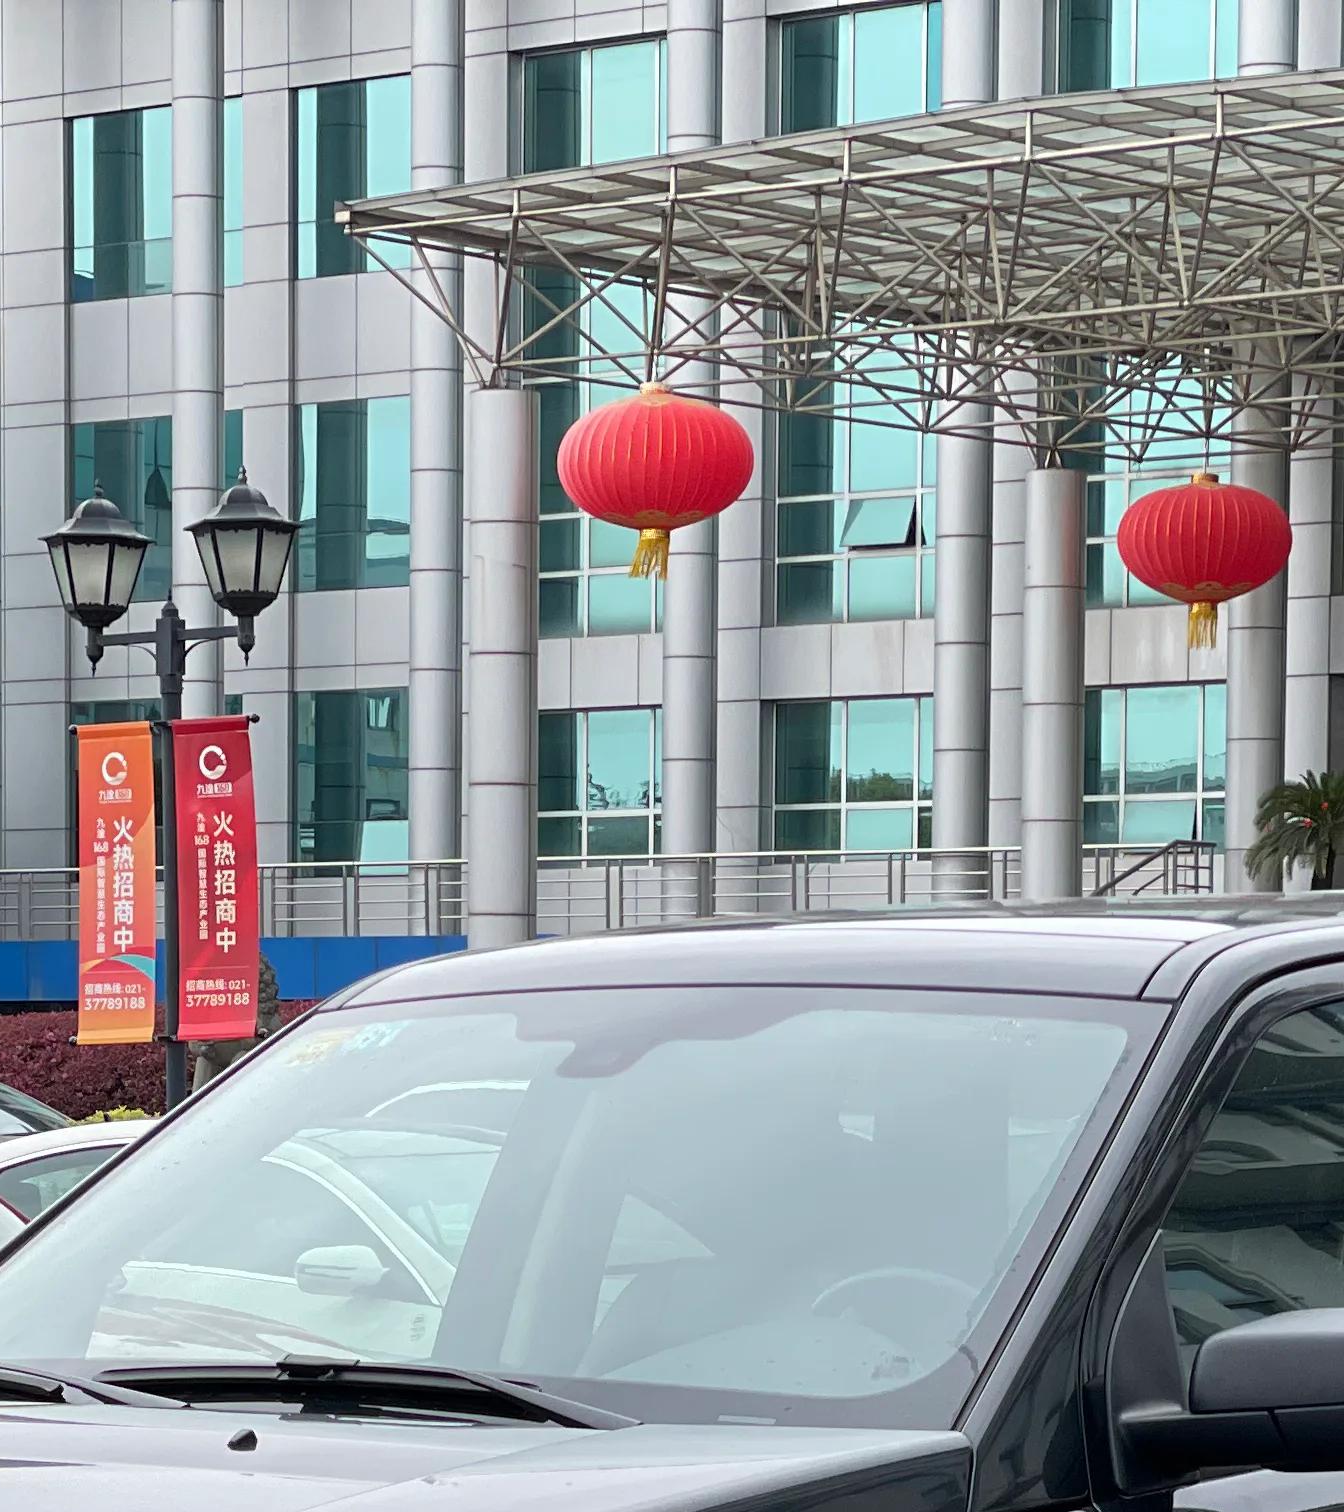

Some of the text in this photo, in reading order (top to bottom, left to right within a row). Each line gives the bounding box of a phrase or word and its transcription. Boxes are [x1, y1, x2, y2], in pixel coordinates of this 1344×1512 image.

[113, 816, 134, 953] 火热招商中
[213, 811, 236, 953] 火热招商中
[84, 997, 146, 1010] 37789188
[186, 993, 250, 1007] 37789188
